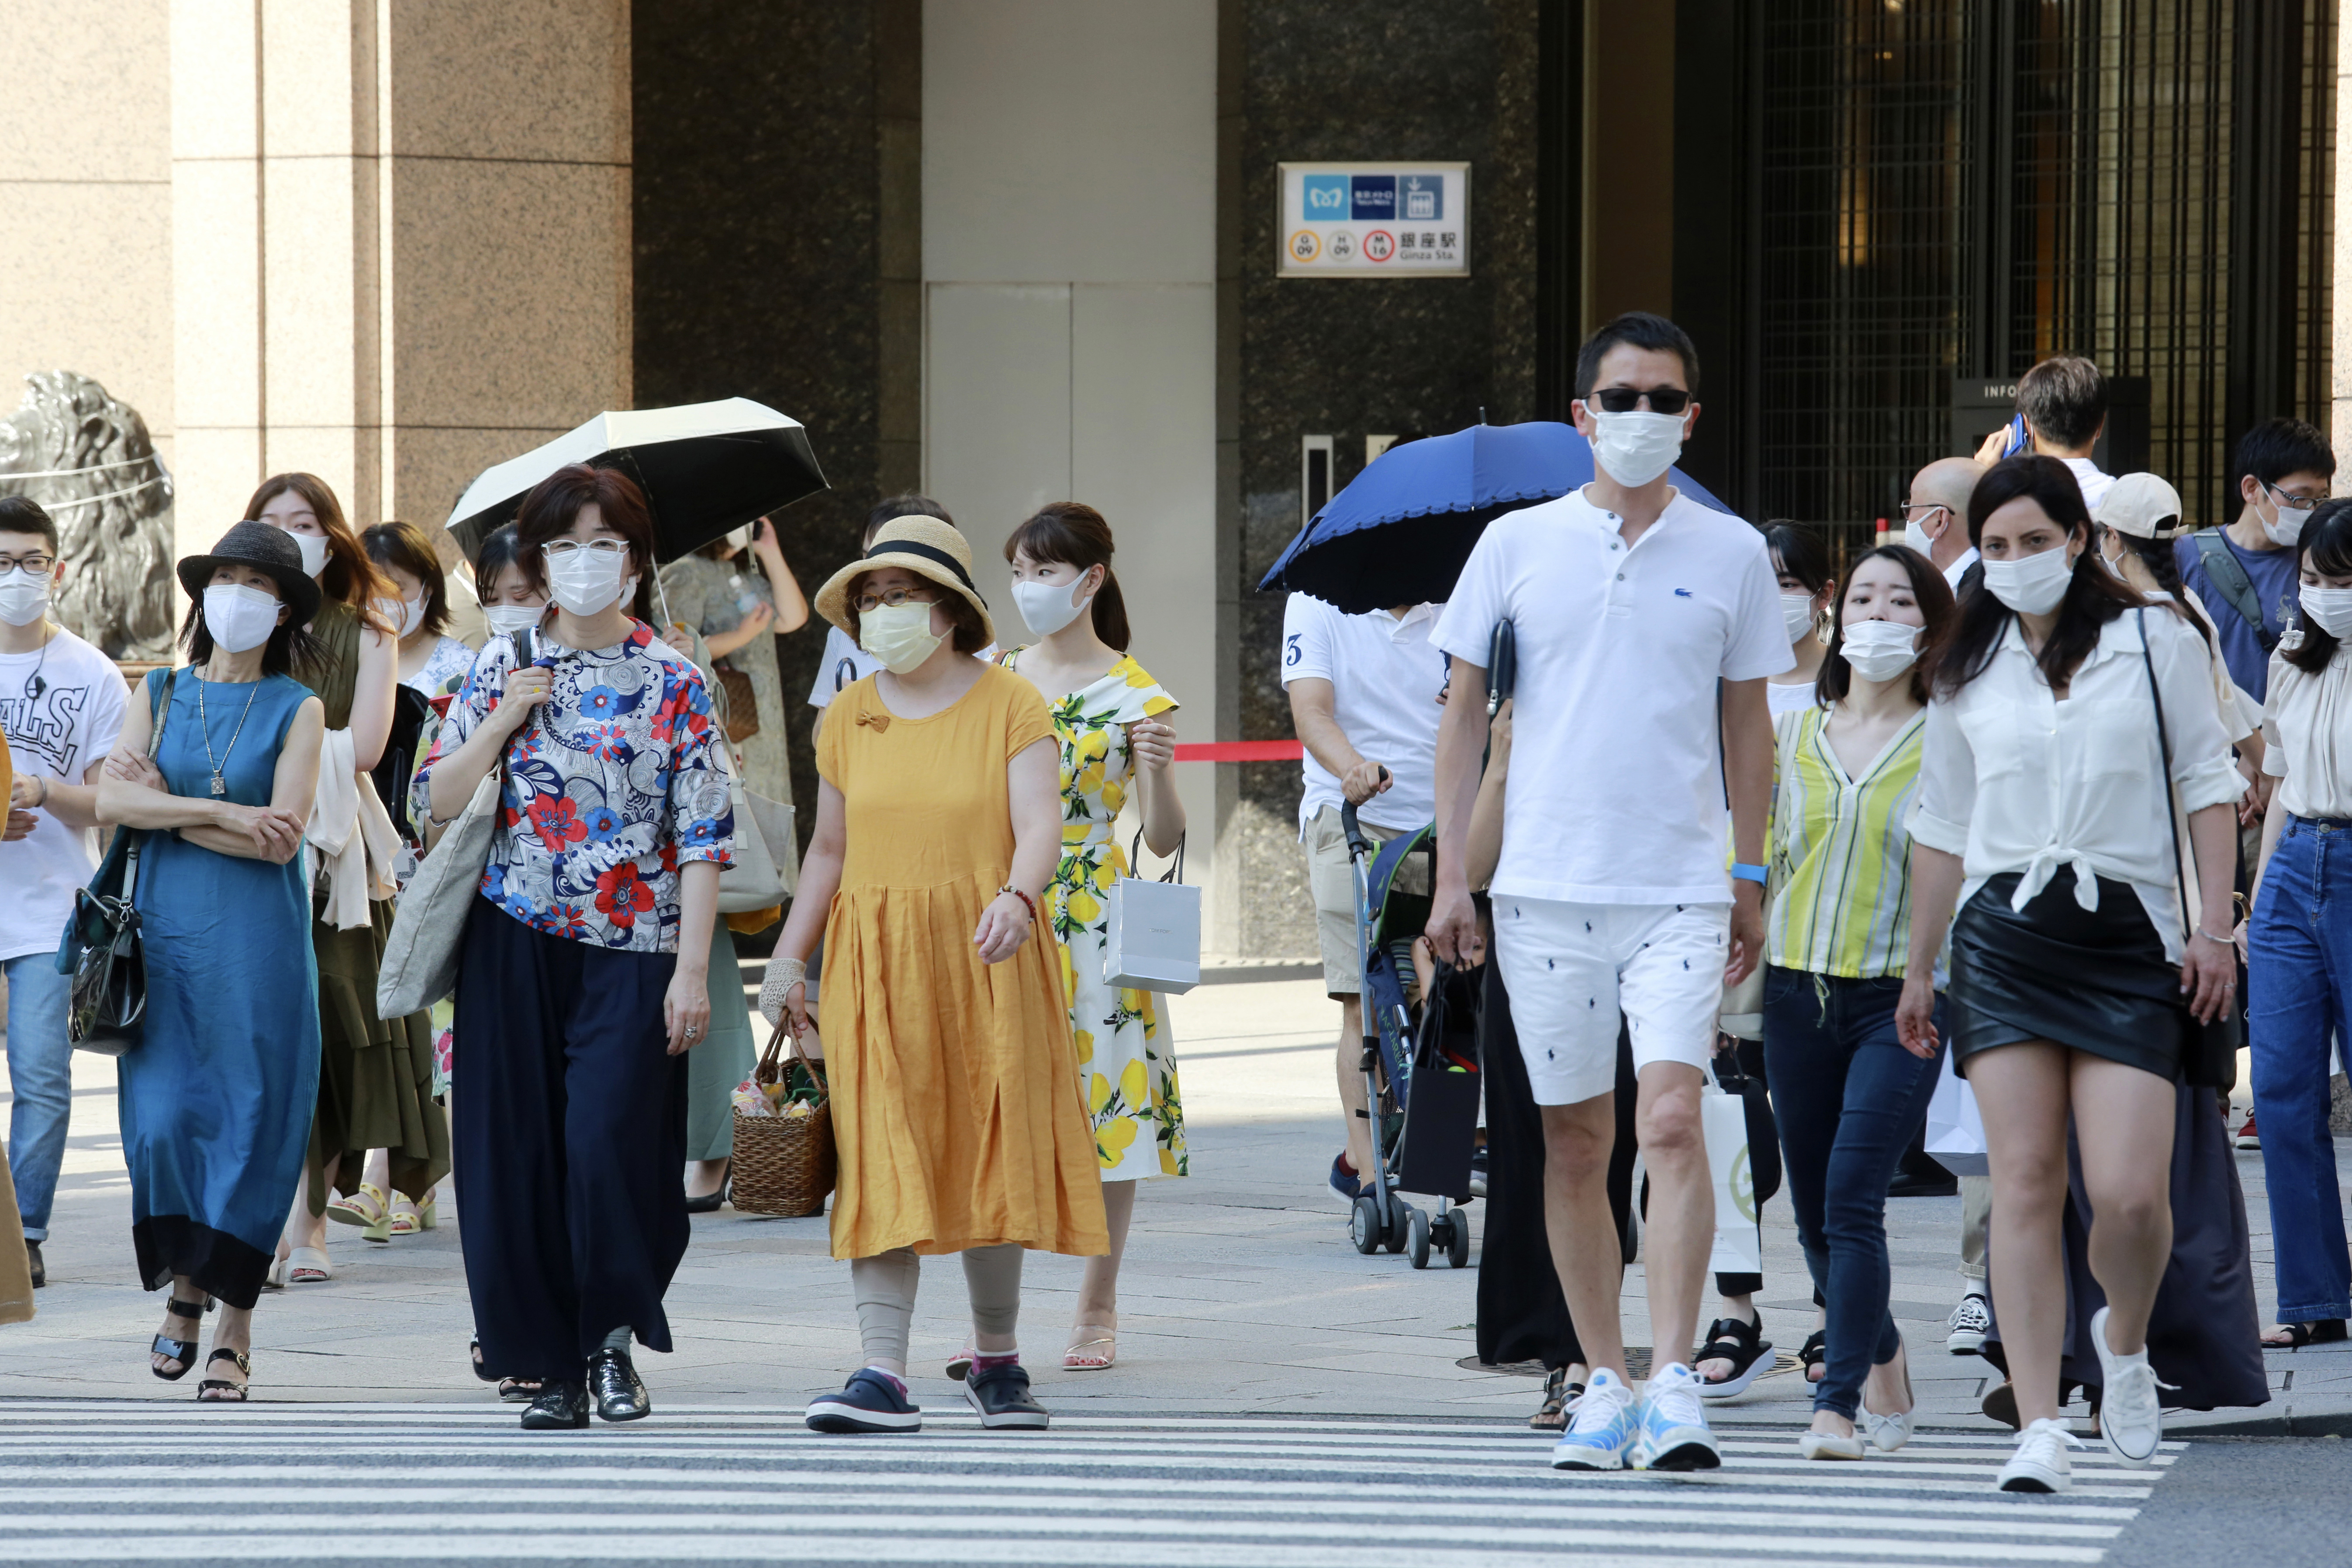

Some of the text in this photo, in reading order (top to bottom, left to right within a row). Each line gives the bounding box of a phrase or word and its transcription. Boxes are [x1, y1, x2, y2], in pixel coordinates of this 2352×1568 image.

[1301, 235, 1309, 244] G
[1400, 231, 1456, 248] 銀座駅
[1297, 245, 1312, 255] 09
[1334, 245, 1350, 255] 09
[1373, 246, 1386, 255] 16
[1400, 250, 1432, 259] Ginza
[1985, 385, 2017, 398] INFO
[1287, 633, 1302, 666] 3
[1380, 1004, 1403, 1071] MACLAREN
